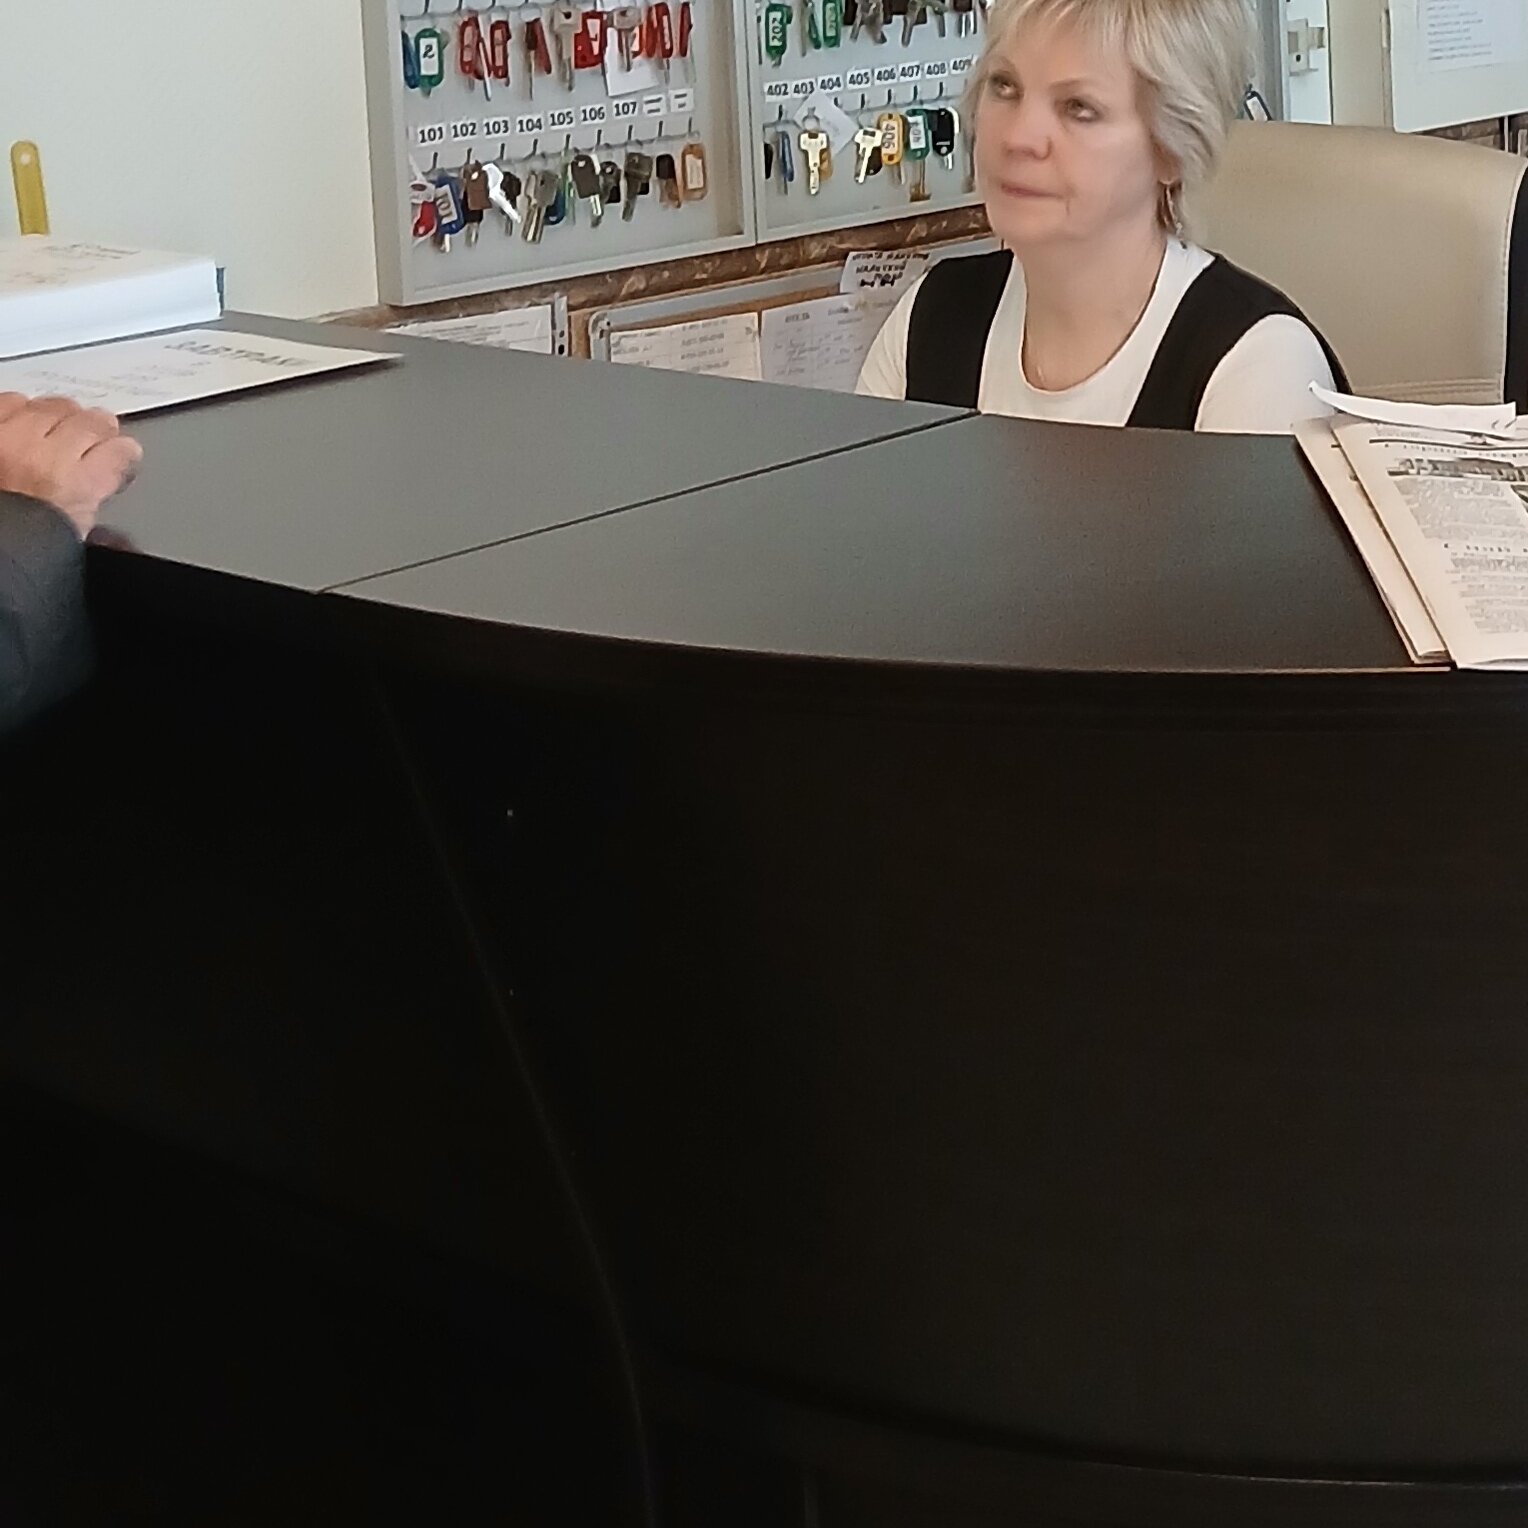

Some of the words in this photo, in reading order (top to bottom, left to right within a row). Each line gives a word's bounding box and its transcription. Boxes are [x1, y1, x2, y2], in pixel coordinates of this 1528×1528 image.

[767, 83, 789, 96] 402
[793, 82, 815, 94] 403
[820, 77, 841, 90] 404
[849, 72, 870, 84] 405
[876, 69, 896, 81] 406
[900, 65, 920, 78] 407
[926, 63, 946, 75] 408
[419, 128, 443, 143] 101
[452, 123, 477, 138] 102
[485, 120, 509, 136] 103
[518, 118, 542, 133] 104
[550, 112, 573, 126] 105
[582, 107, 605, 121] 106
[614, 102, 637, 117] 107
